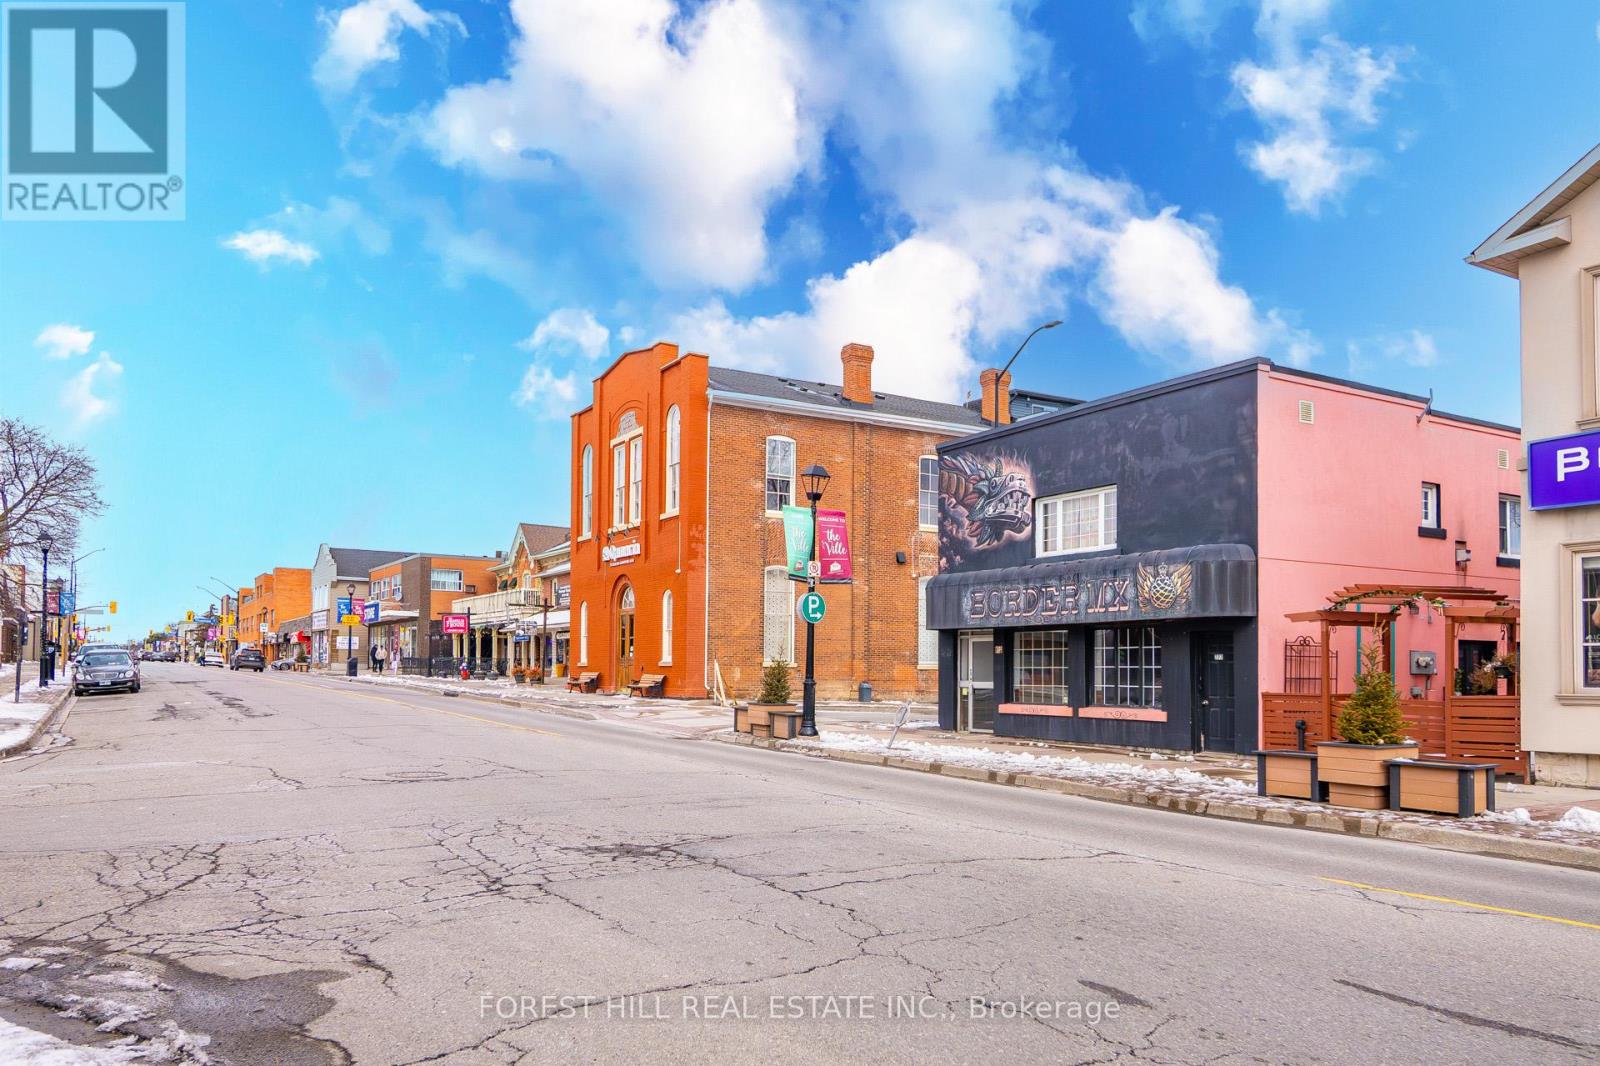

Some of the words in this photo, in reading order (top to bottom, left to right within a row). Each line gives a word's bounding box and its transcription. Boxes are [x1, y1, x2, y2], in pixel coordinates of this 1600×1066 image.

[825, 528, 841, 541] the
[823, 540, 848, 556] Ville
[808, 595, 820, 614] P
[969, 582, 1081, 619] BORDER
[1086, 577, 1131, 613] MX
